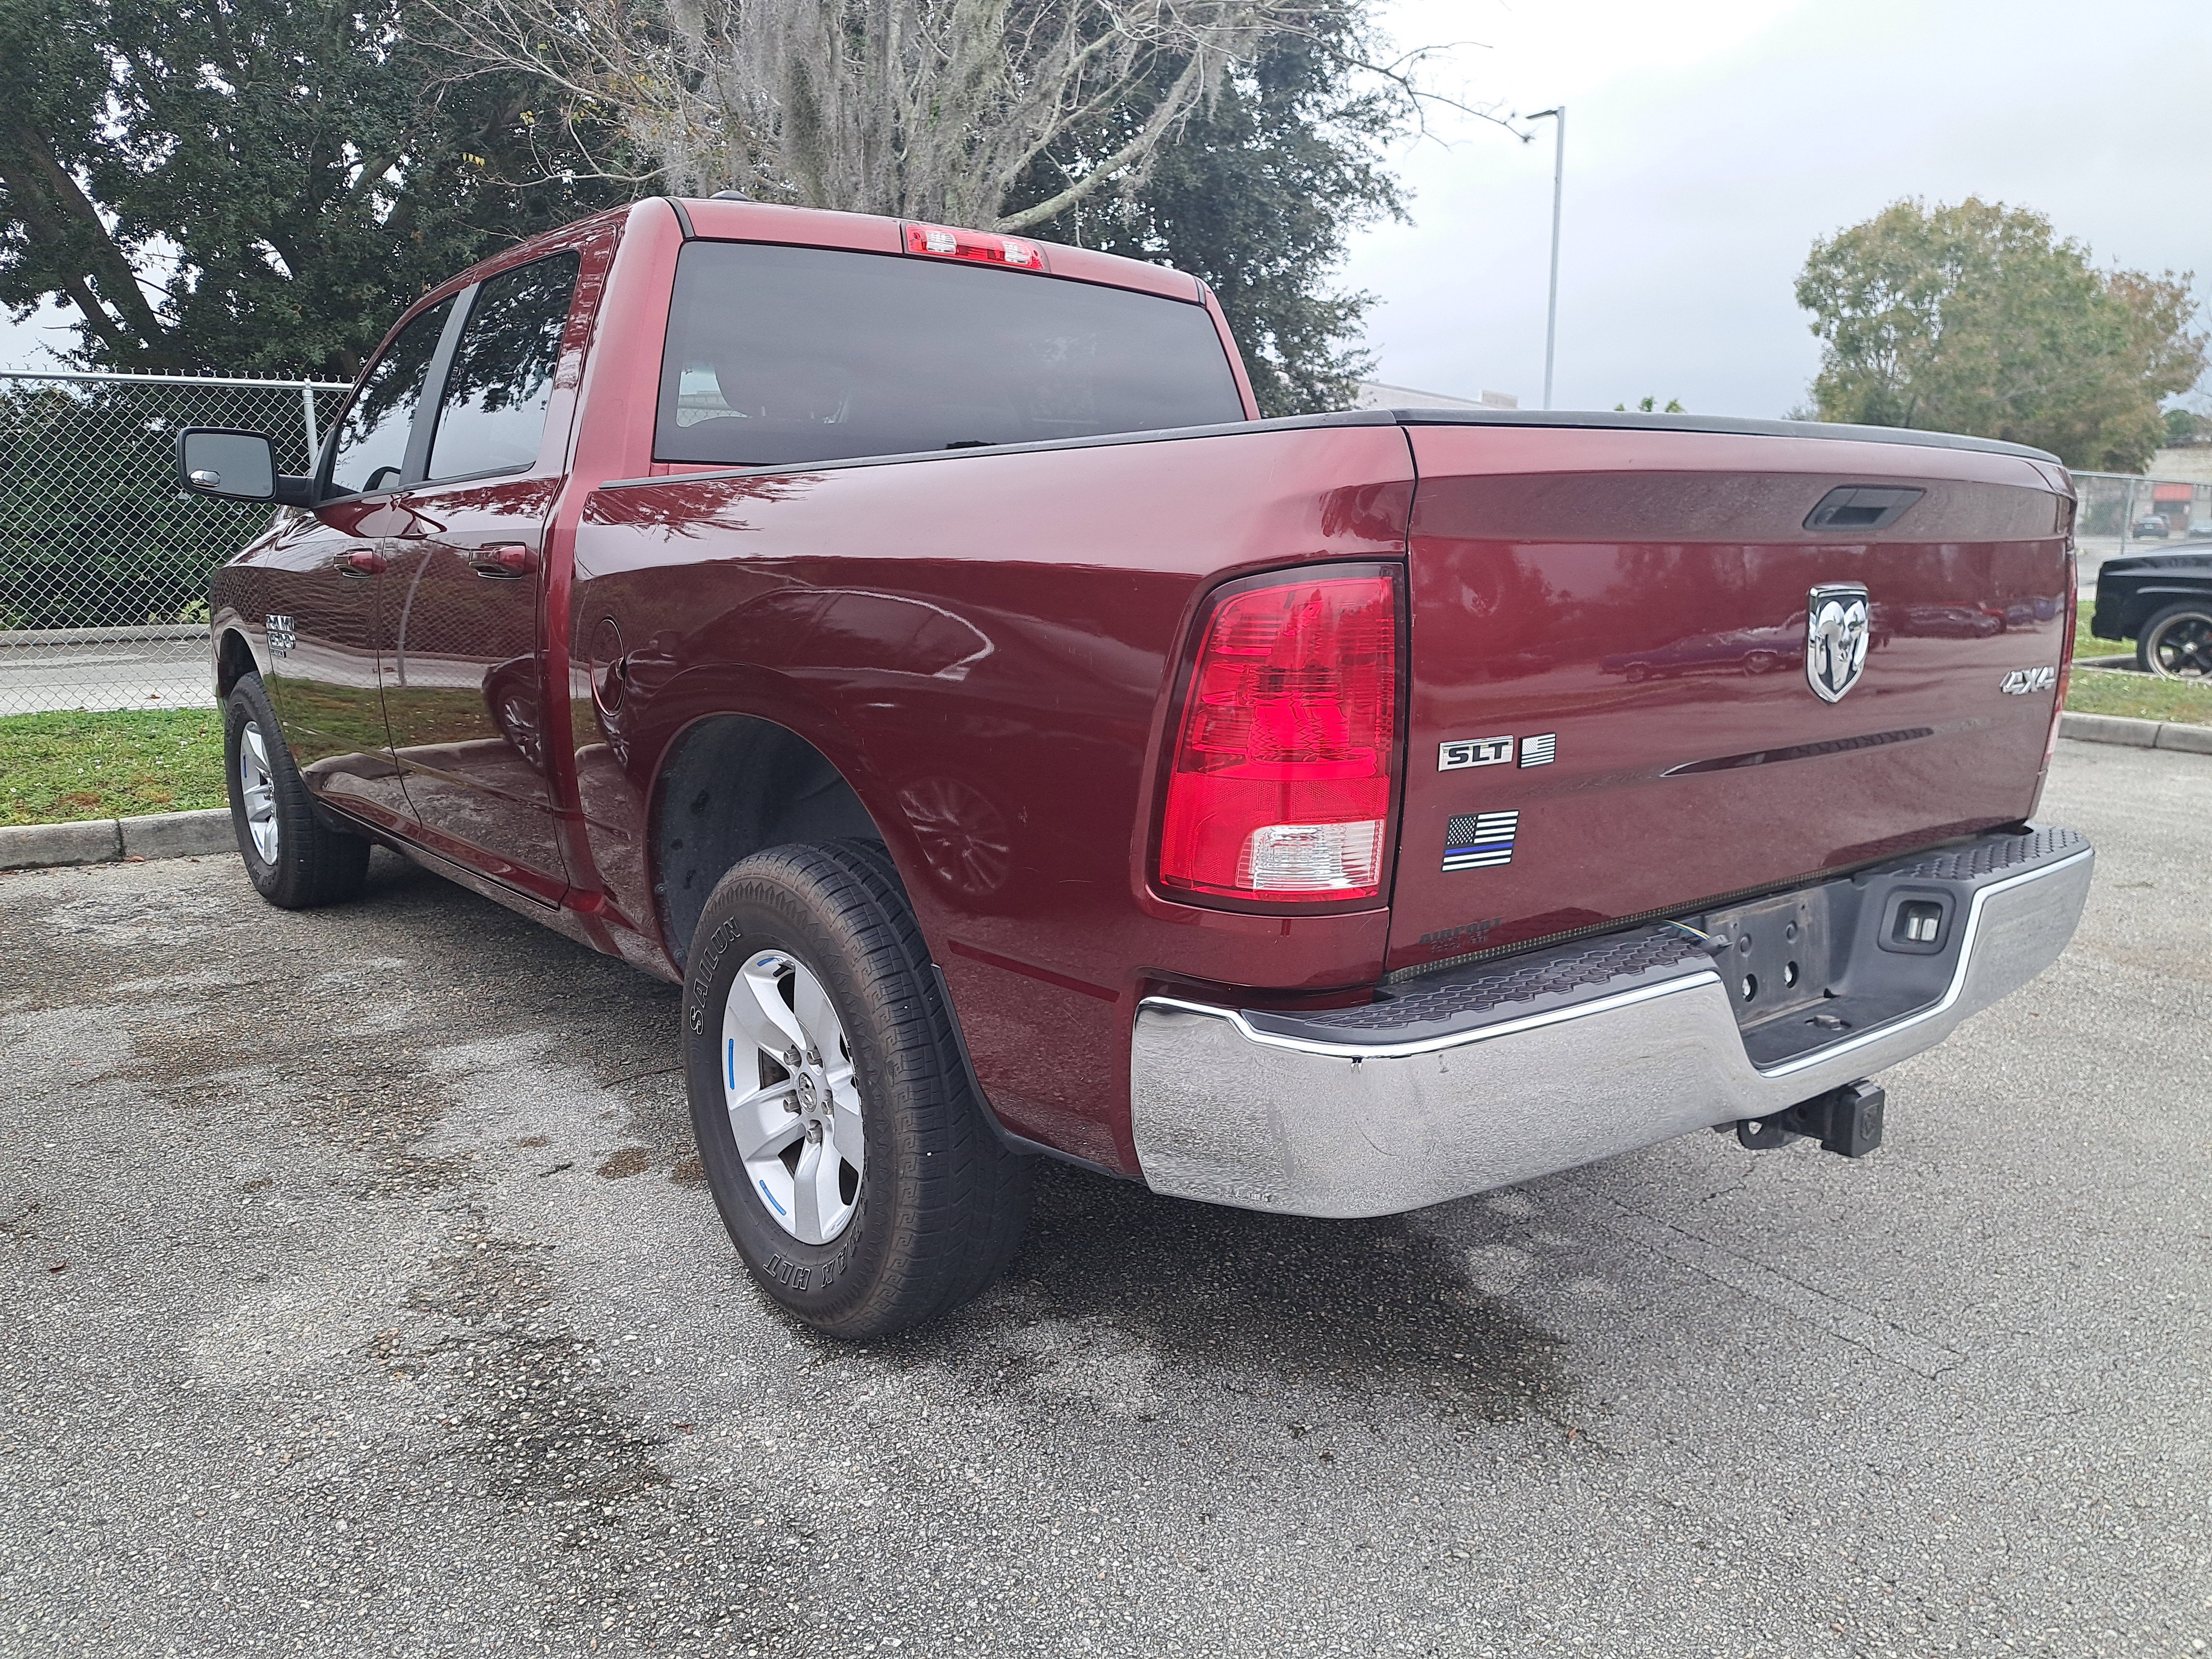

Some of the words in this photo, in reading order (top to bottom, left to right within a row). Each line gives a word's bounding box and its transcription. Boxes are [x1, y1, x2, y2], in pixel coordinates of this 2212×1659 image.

[1447, 741, 1509, 765] SLT
[1418, 916, 1504, 944] AIRPORT
[689, 915, 741, 1035] SAILUN
[762, 1253, 810, 1290] HLT
